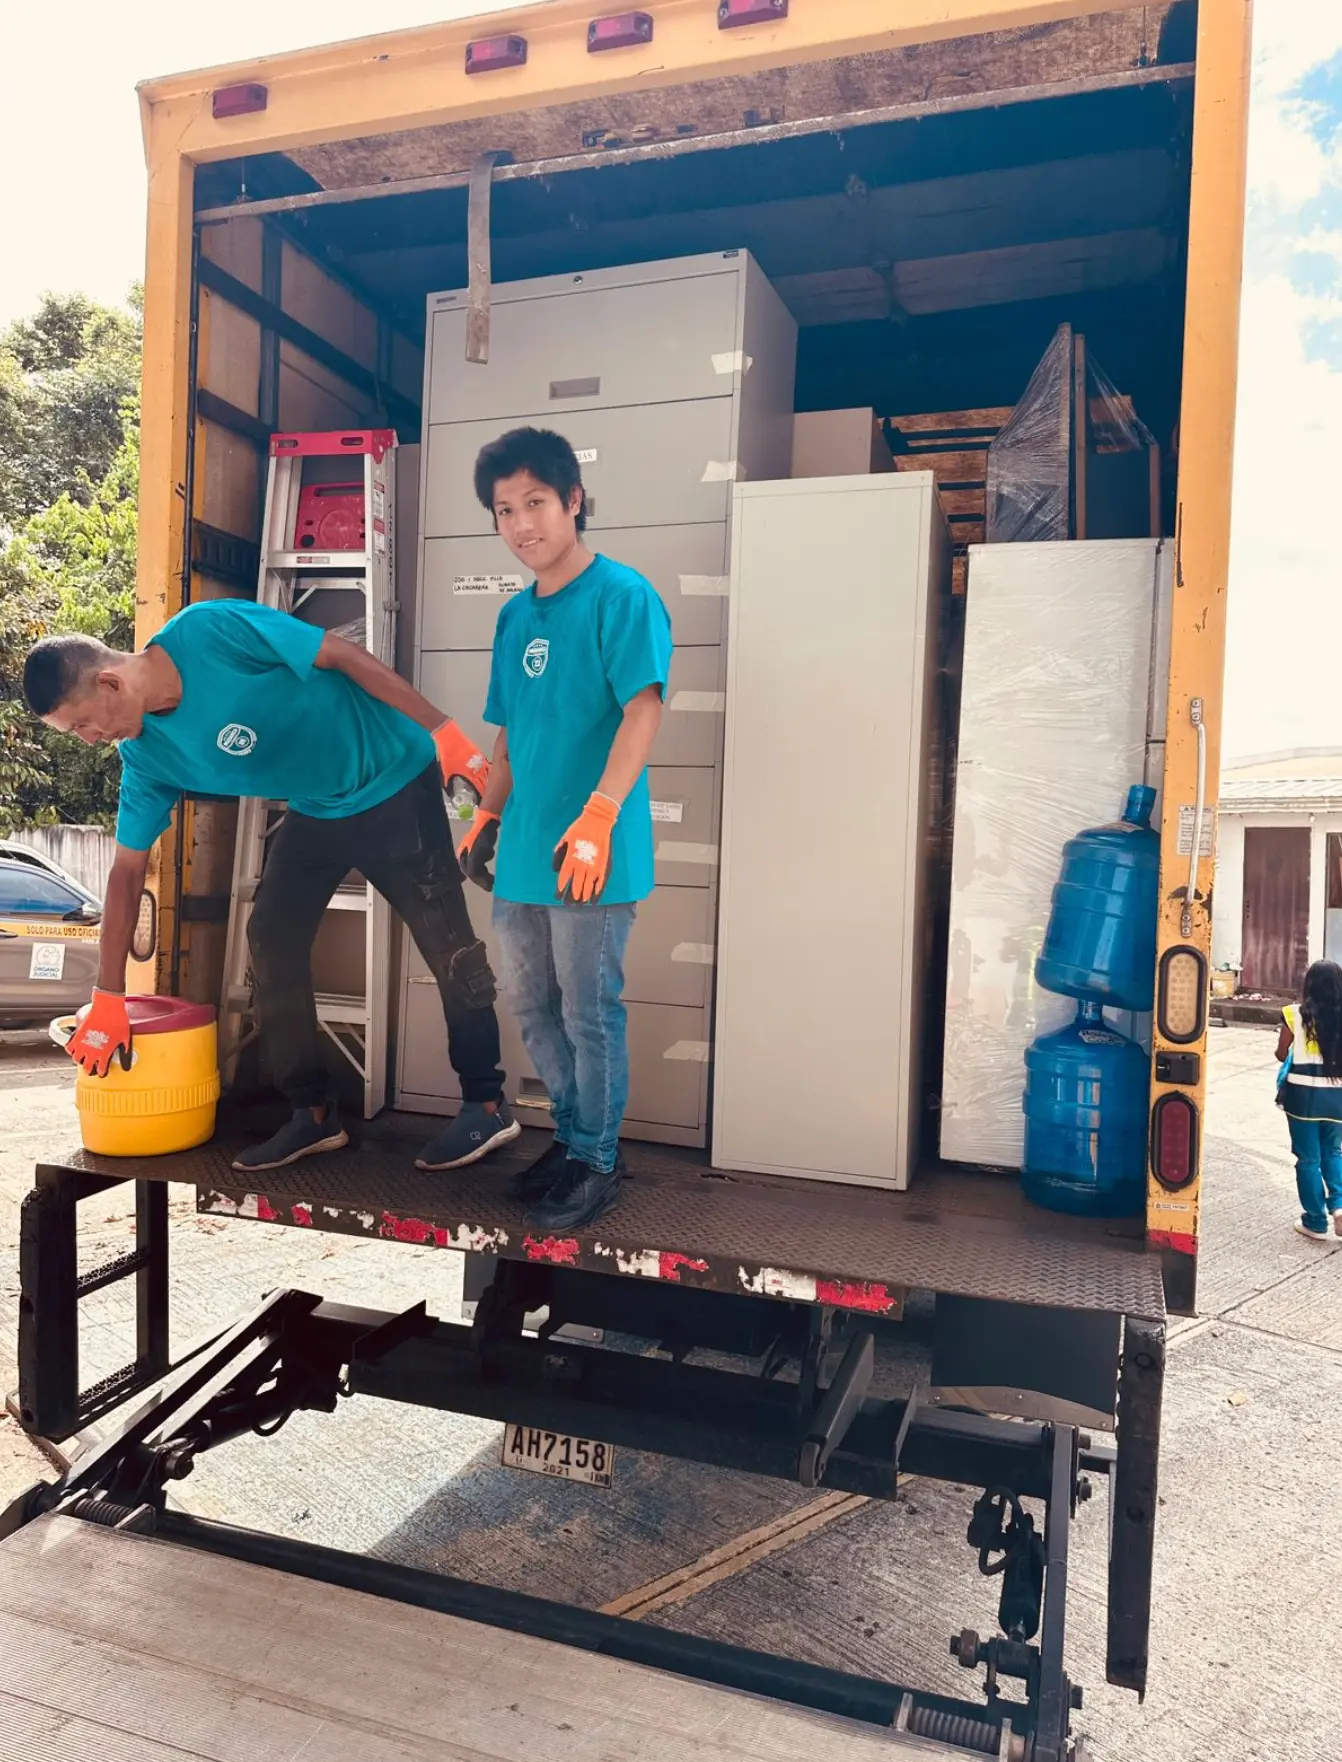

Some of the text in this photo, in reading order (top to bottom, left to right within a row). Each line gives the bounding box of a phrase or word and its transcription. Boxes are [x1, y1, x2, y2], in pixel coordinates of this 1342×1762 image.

[26, 925, 44, 935] SOLO
[45, 926, 62, 936] PARA
[63, 927, 77, 937] USO
[511, 1425, 606, 1472] AH7158
[542, 1462, 570, 1477] 2021
